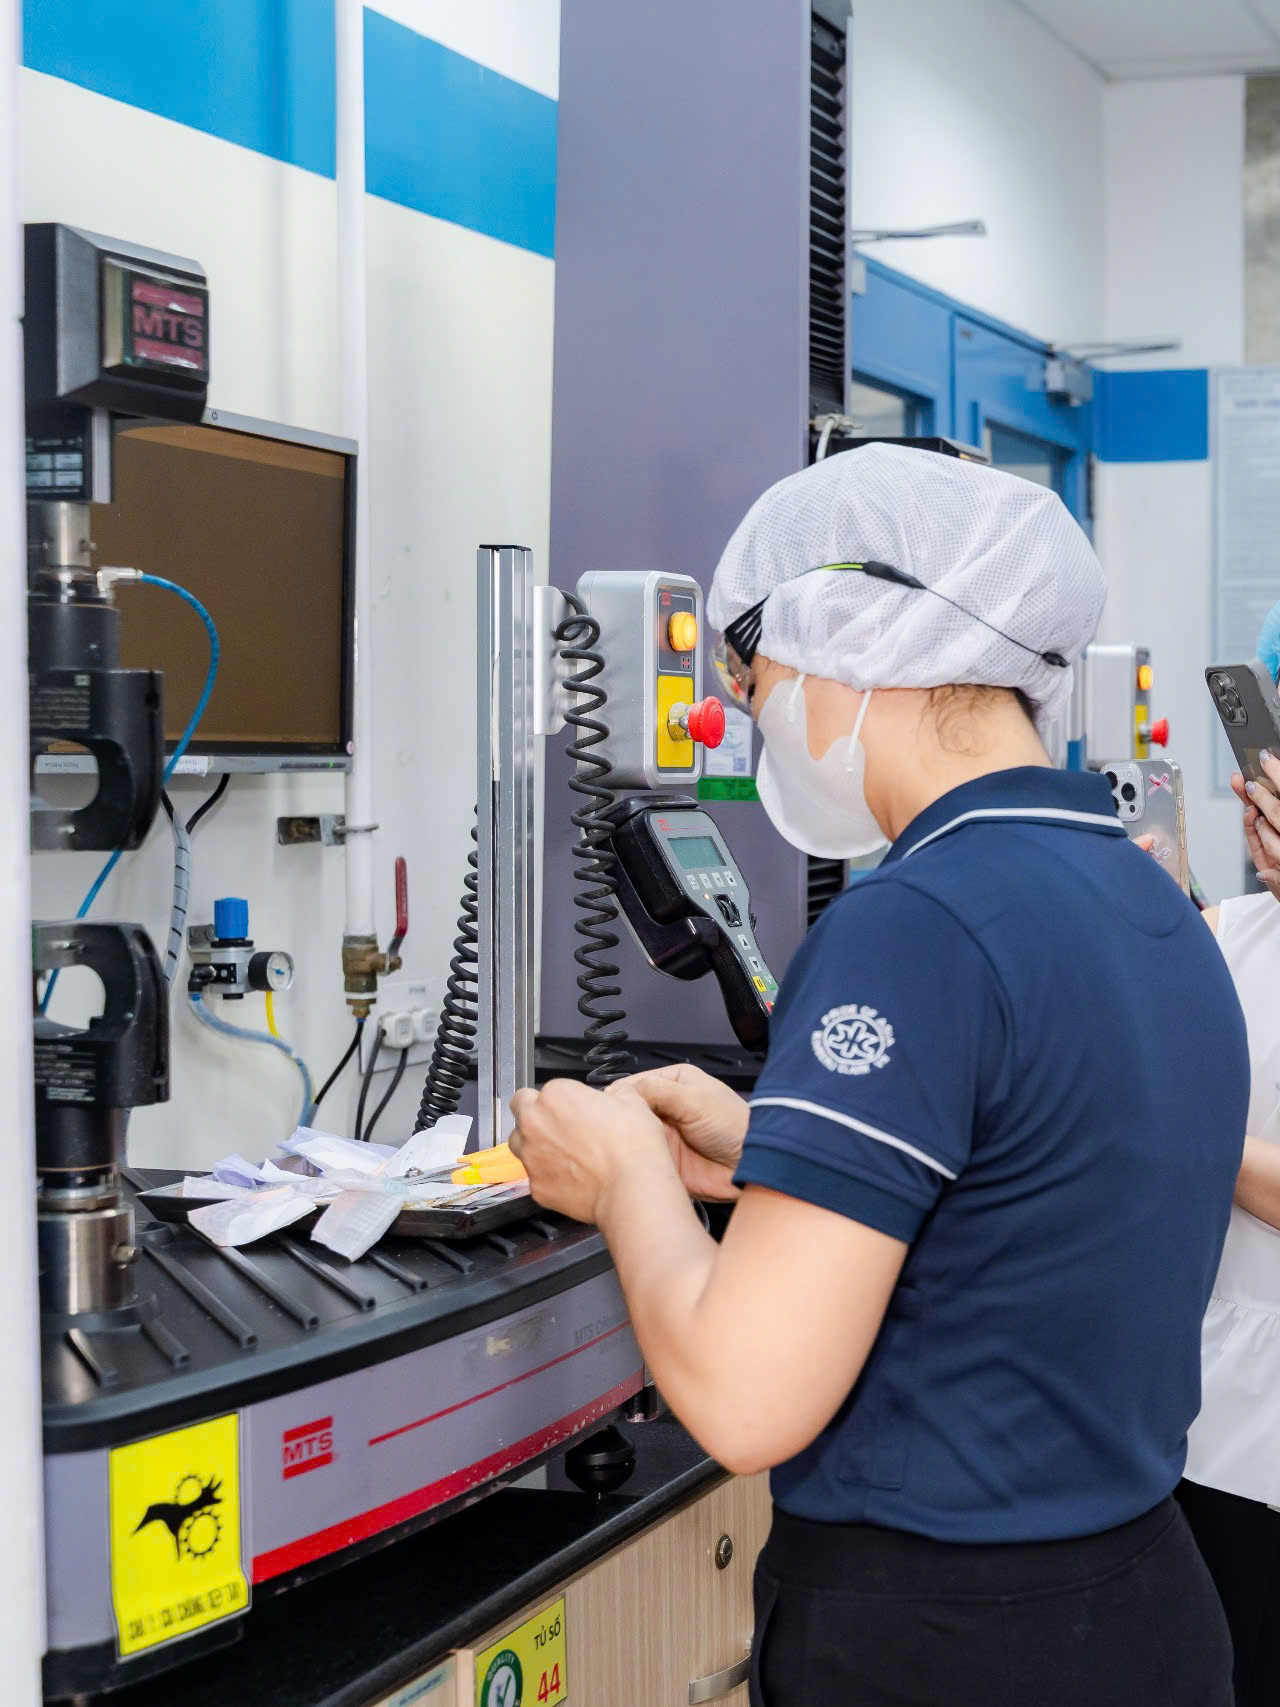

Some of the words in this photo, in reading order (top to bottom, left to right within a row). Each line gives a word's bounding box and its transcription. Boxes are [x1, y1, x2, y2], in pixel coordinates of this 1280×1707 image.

[133, 304, 204, 348] MTS
[283, 1432, 333, 1465] MTS
[534, 1625, 547, 1651] TỦ
[549, 1613, 561, 1641] SỐ
[538, 1663, 561, 1703] 44
